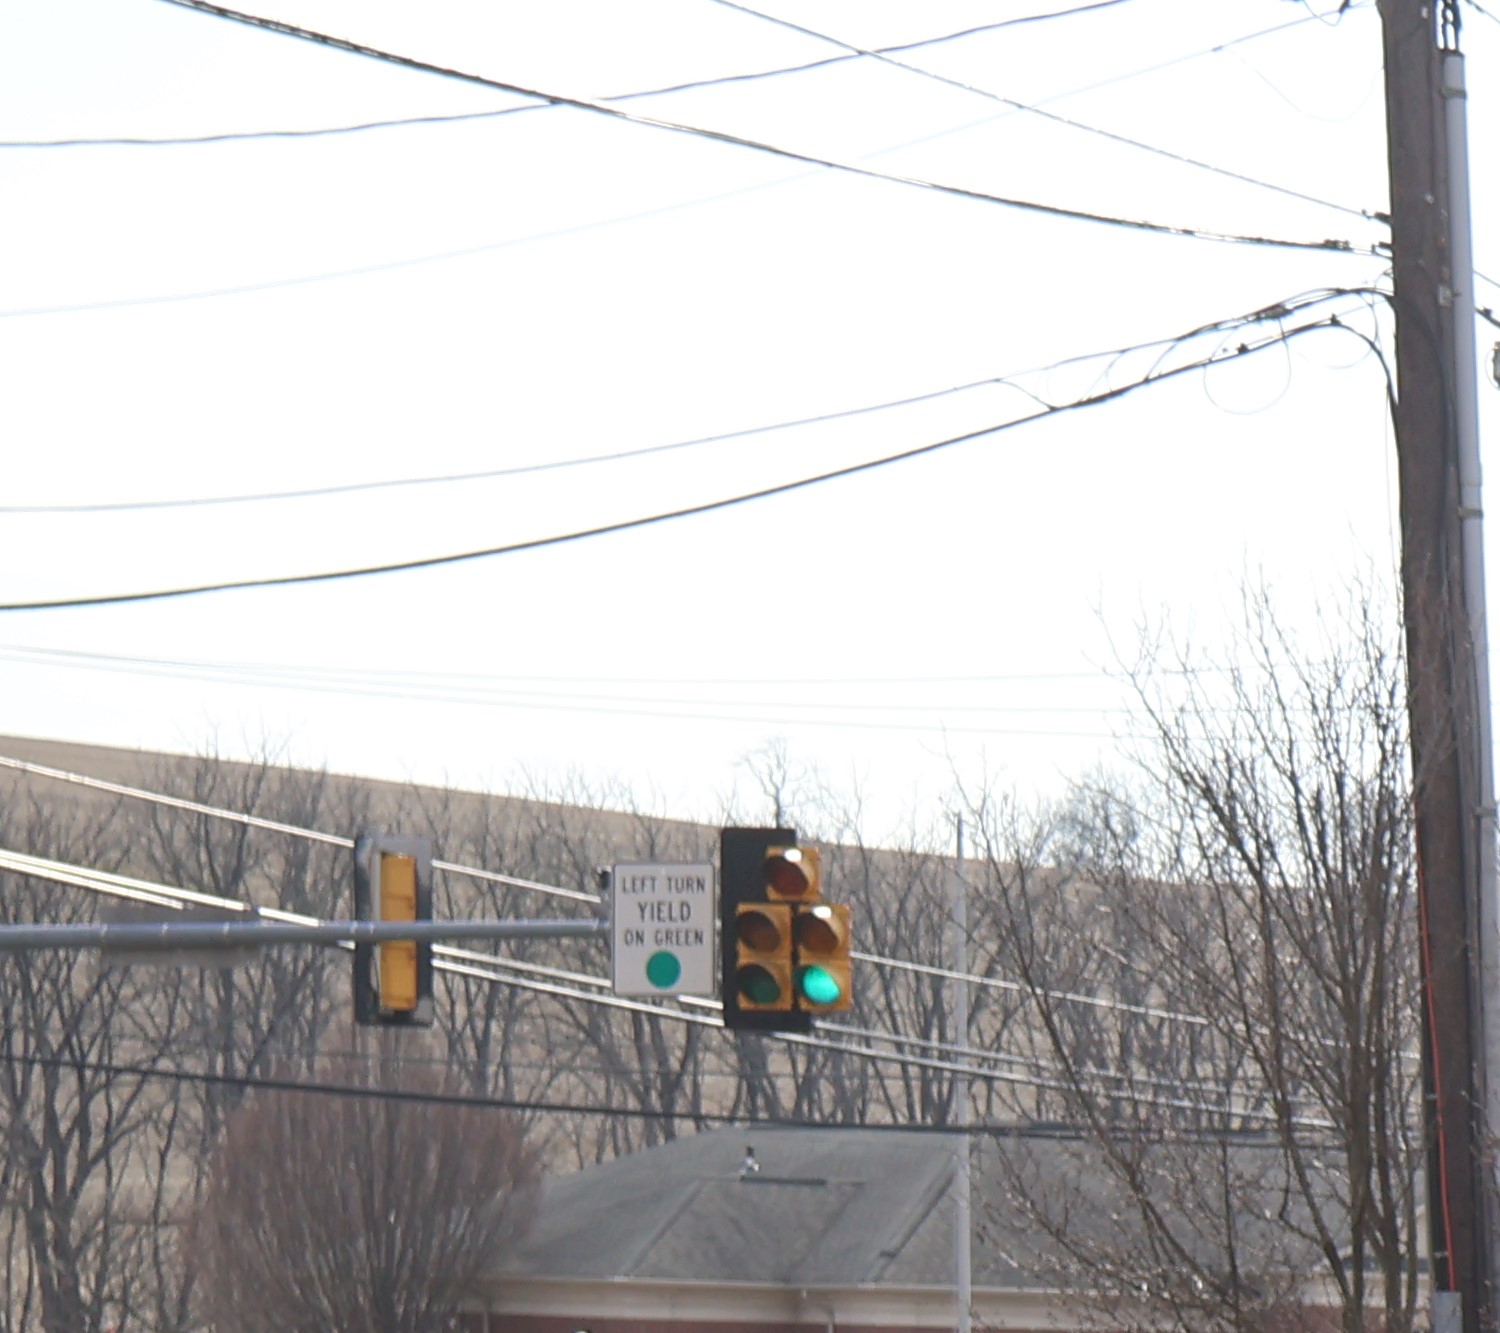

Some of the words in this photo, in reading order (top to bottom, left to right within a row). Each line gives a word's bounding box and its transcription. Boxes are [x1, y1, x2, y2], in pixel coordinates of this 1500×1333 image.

[622, 875, 656, 893] LEFT
[666, 876, 706, 893] TURN
[638, 901, 692, 922] YIELD
[624, 928, 645, 946] ON
[654, 928, 705, 946] GREEN
